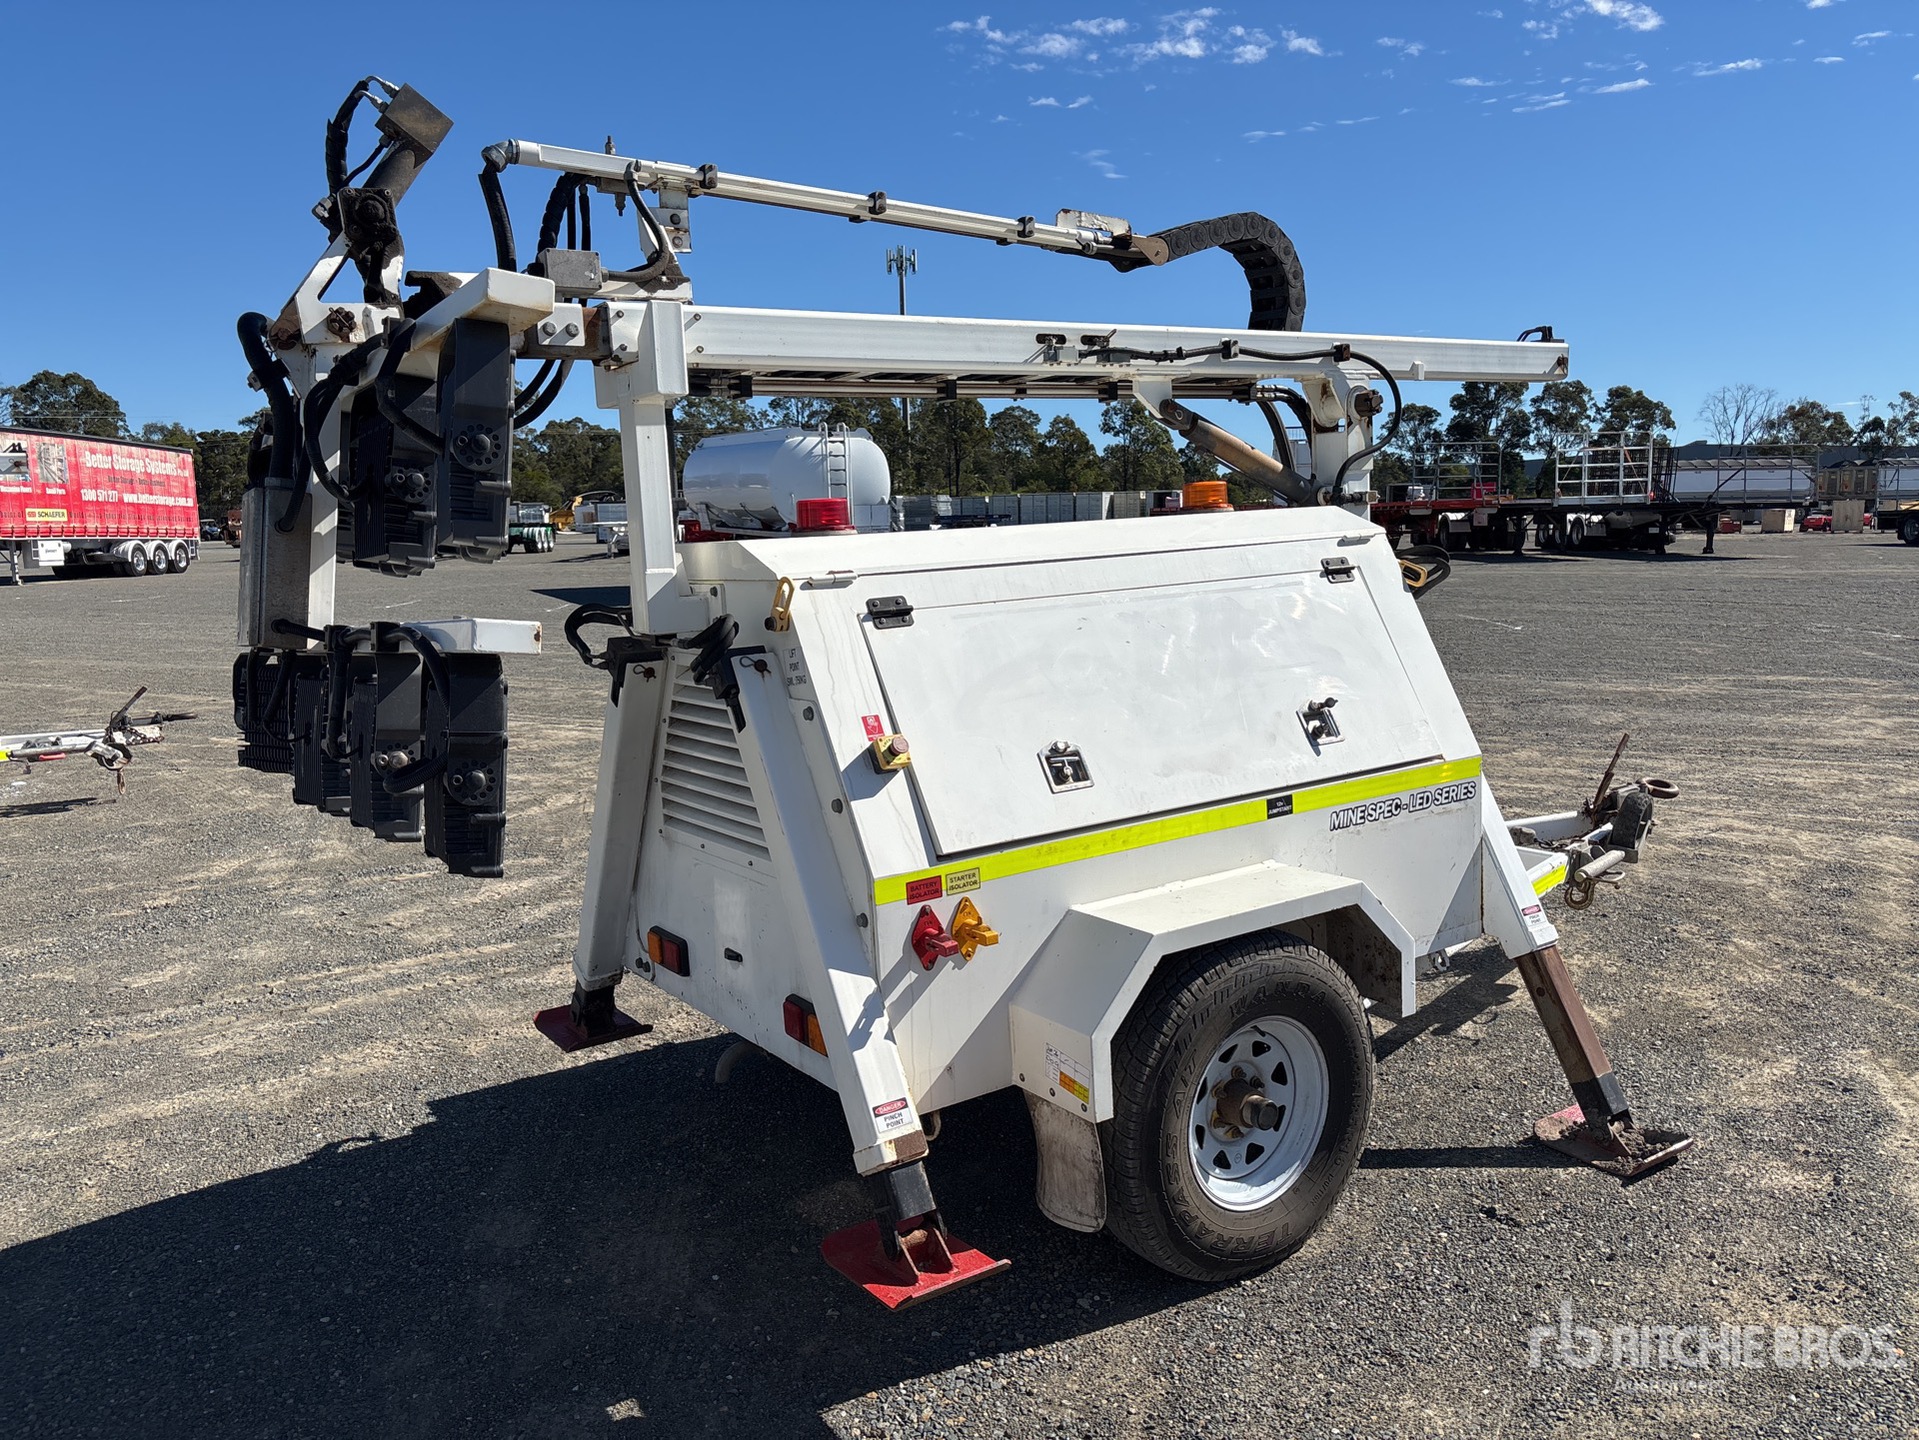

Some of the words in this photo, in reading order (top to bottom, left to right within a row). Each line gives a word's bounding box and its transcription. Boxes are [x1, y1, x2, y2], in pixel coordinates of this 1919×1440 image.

[85, 451, 112, 469] Better
[112, 454, 145, 473] Storage
[145, 458, 177, 476] Systems
[81, 489, 97, 502] 1300
[1330, 805, 1366, 831] MINE
[1366, 798, 1402, 823] SPEC
[1408, 791, 1433, 813] LED
[1433, 781, 1476, 807] SERIES
[949, 872, 976, 883] STARTER
[910, 881, 938, 892] BATTERY
[949, 881, 978, 891] ISOLATOR
[910, 888, 939, 900] ISOLATOR
[883, 1111, 903, 1122] PINCH
[886, 1118, 905, 1128] POINT
